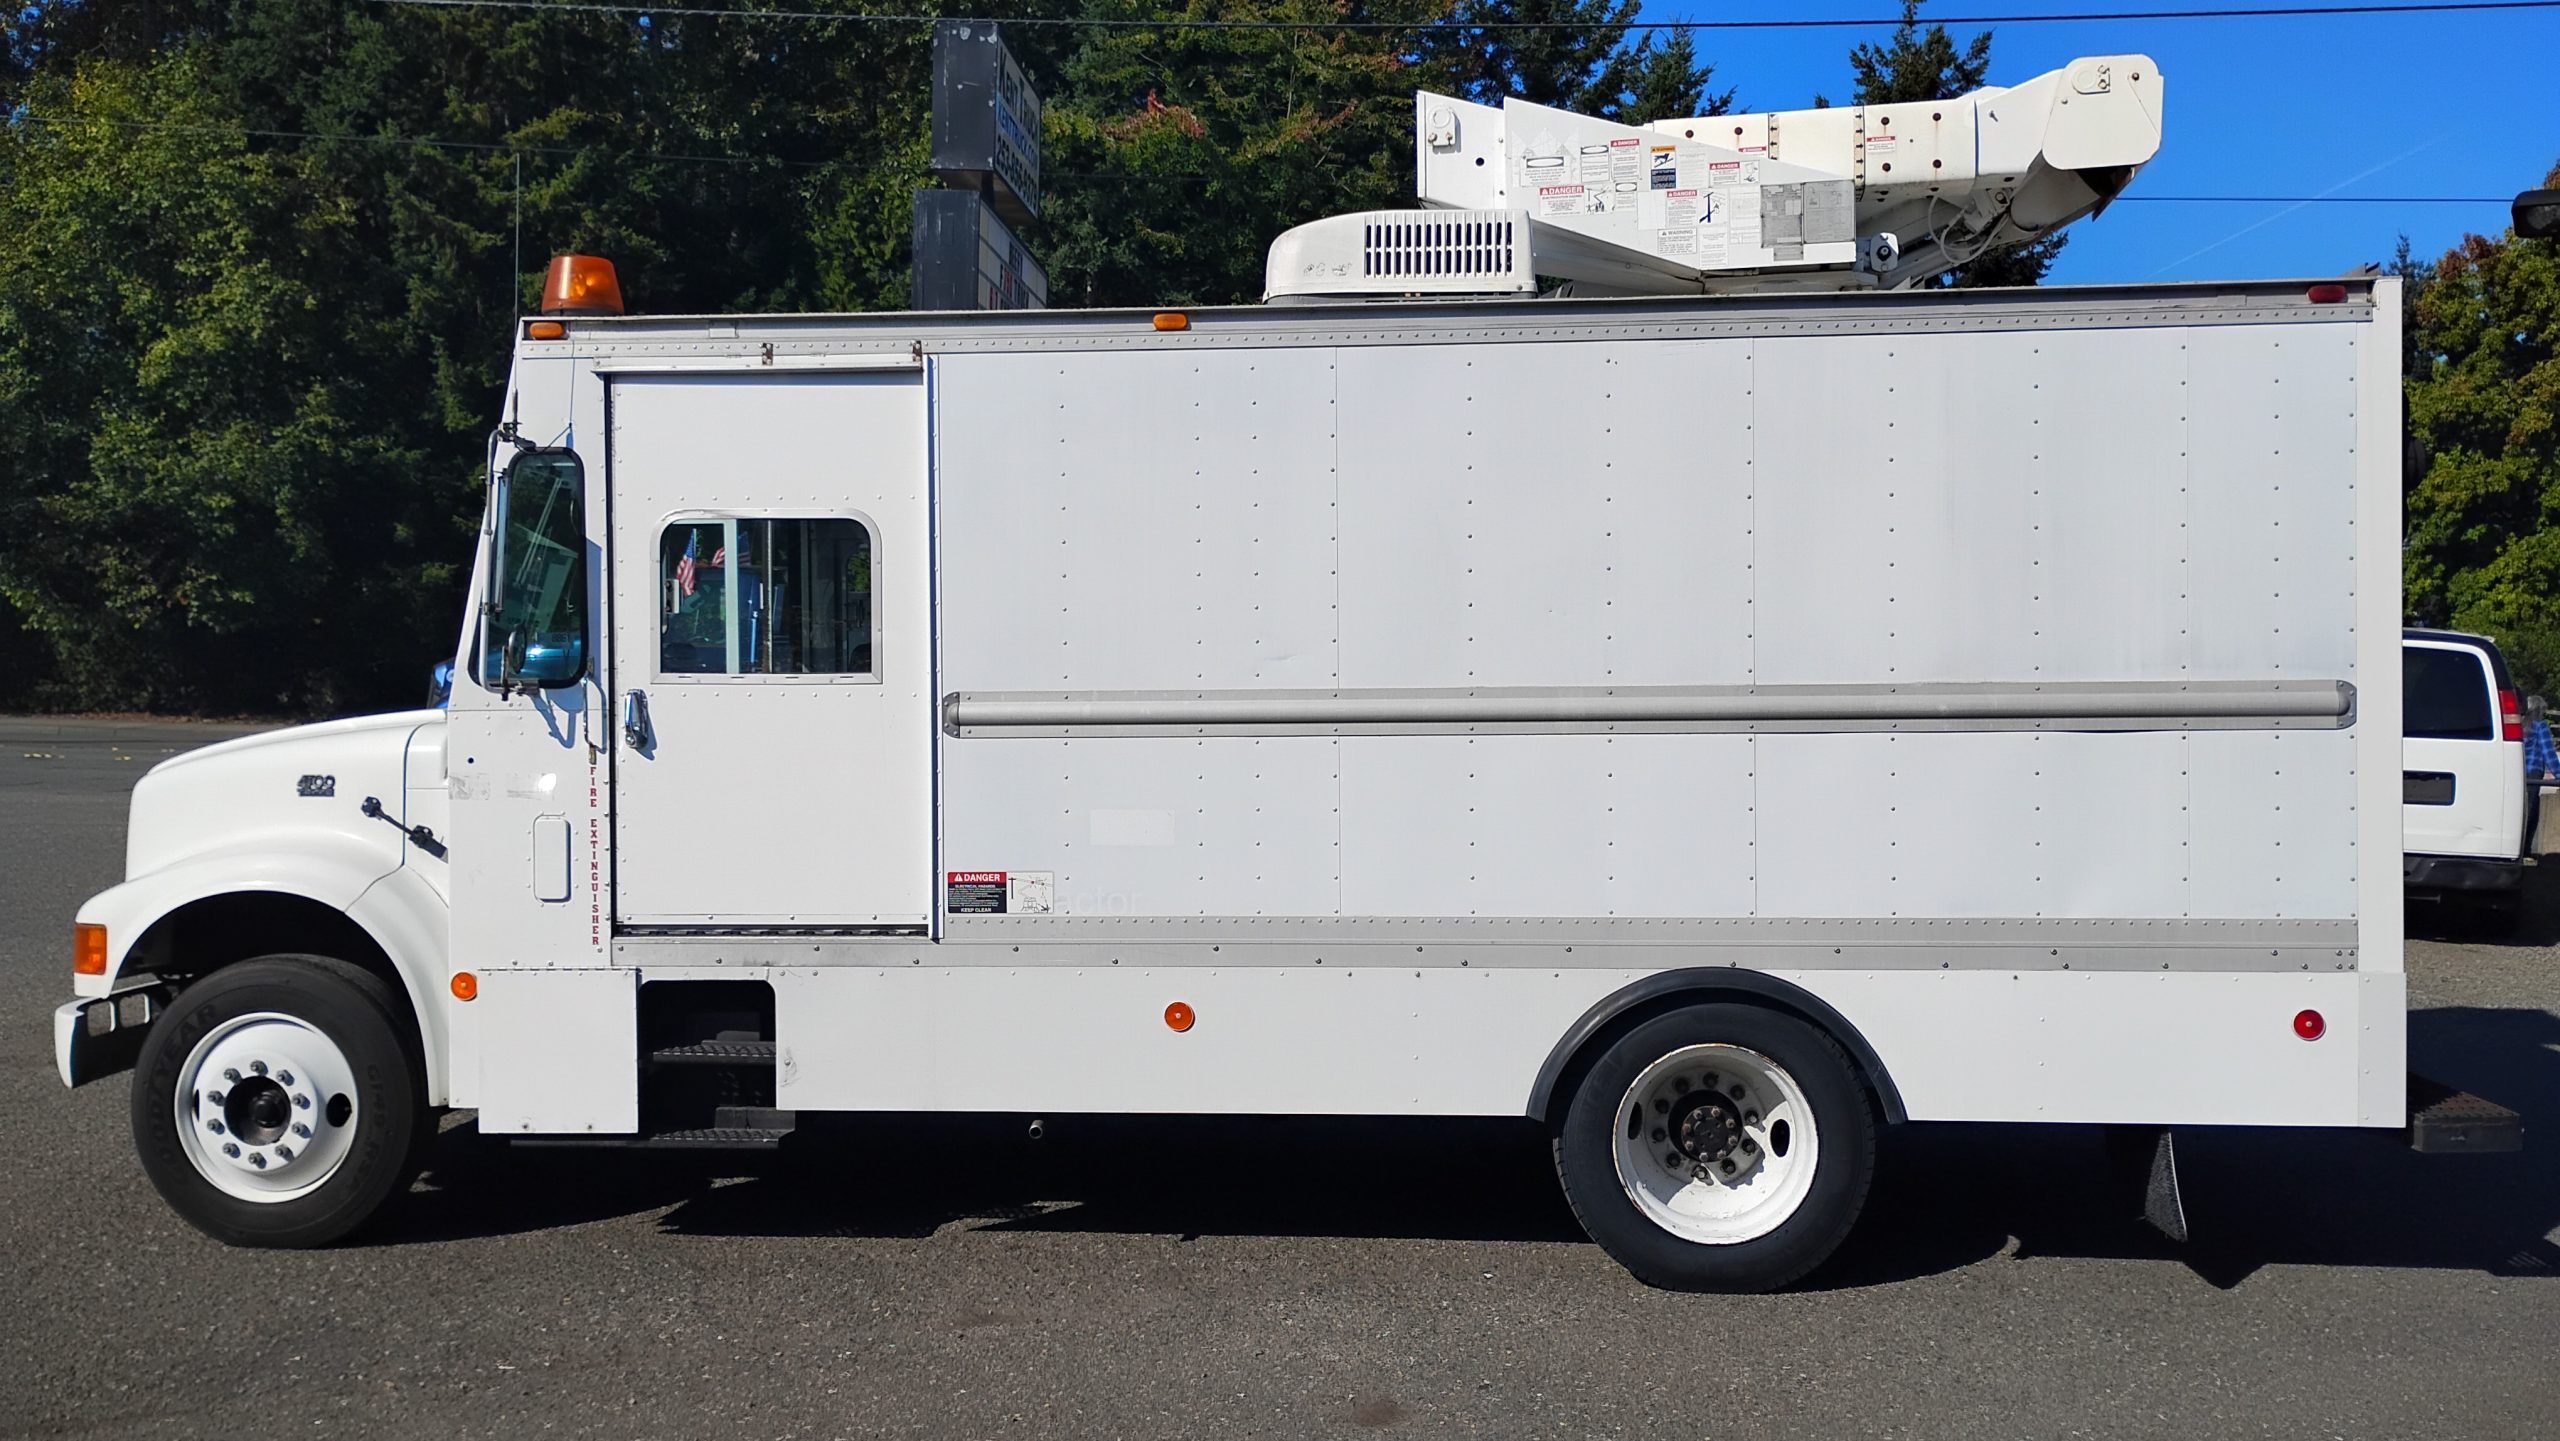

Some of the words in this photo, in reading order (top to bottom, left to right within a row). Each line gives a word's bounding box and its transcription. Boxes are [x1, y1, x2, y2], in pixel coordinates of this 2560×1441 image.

[1549, 186, 1583, 195] DANGER
[589, 767, 597, 807] FIRE
[590, 819, 599, 945] EXTINGUISHER
[963, 873, 1000, 882] DANGER
